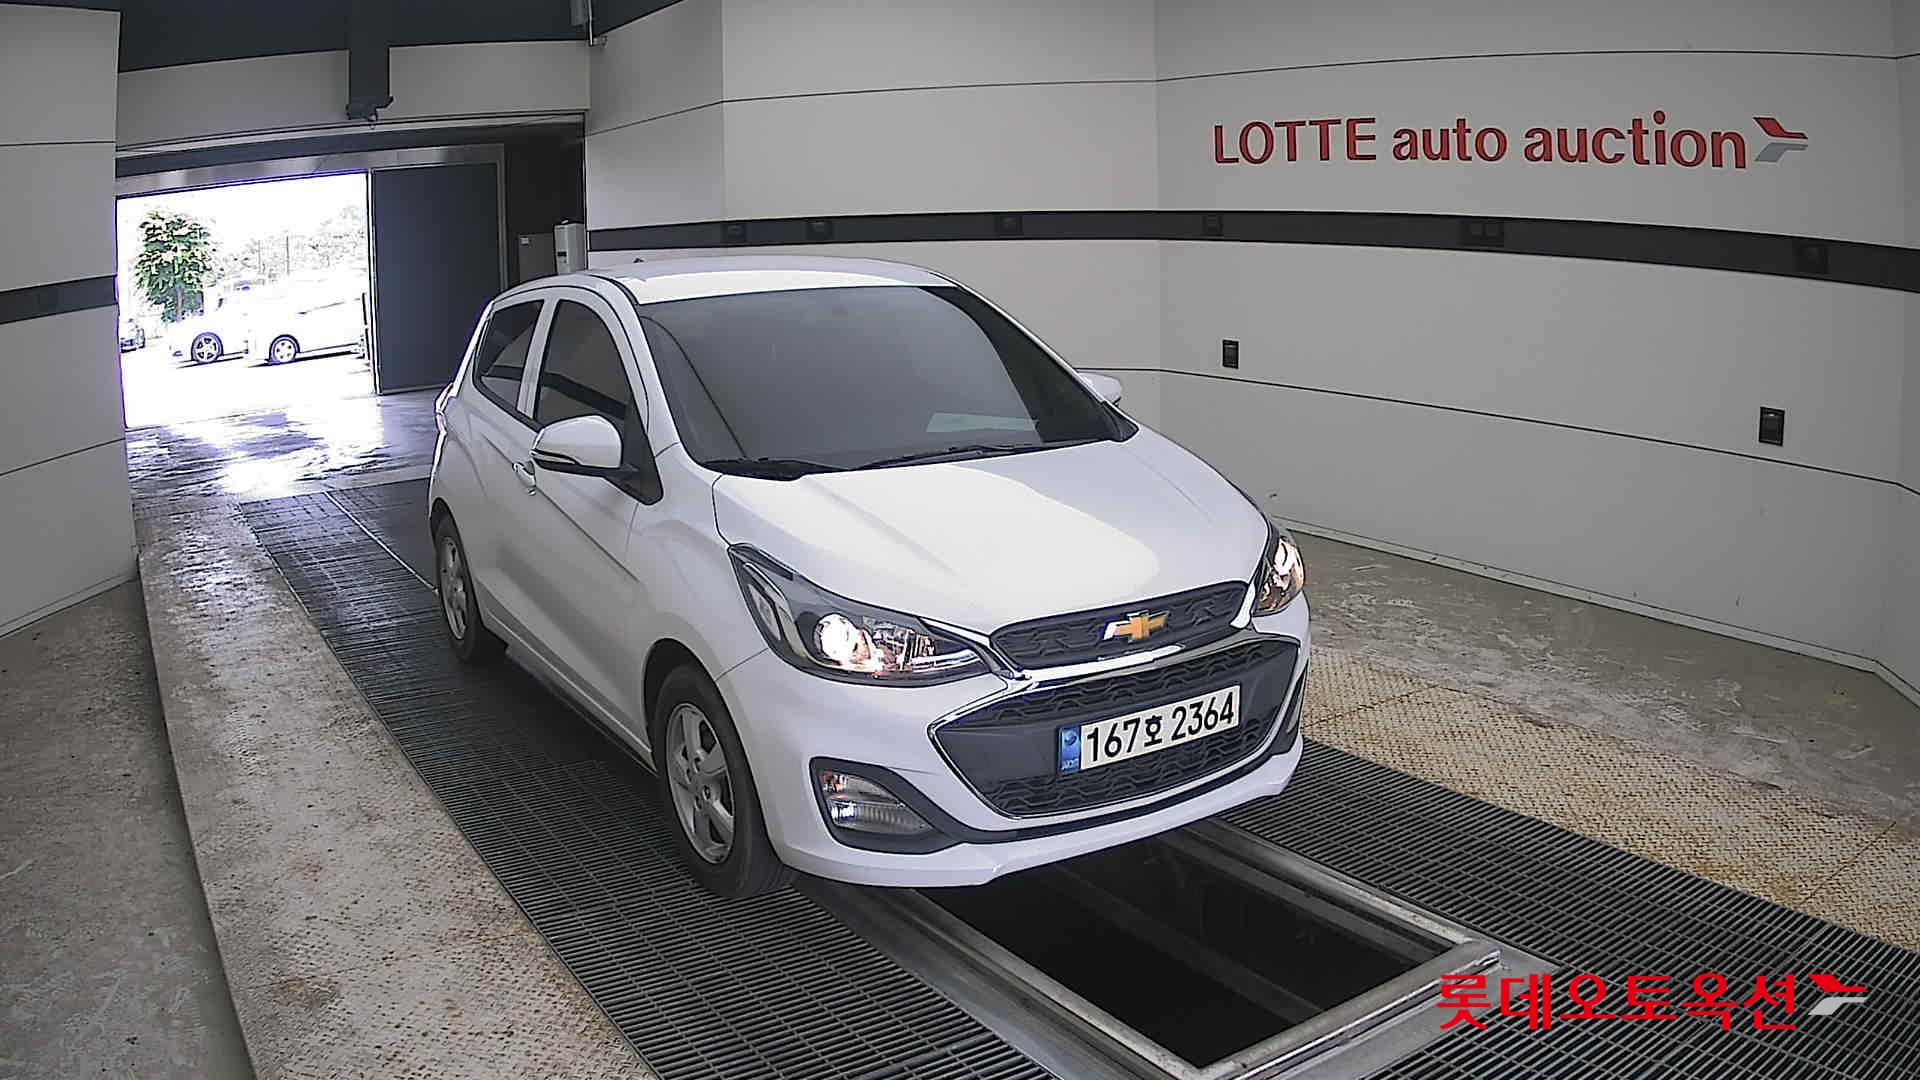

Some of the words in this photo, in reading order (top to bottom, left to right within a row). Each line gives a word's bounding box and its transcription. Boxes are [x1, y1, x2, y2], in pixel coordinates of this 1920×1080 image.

[1213, 116, 1378, 165] LOTTE
[1392, 117, 1508, 163] auto
[1523, 110, 1748, 169] auction
[1087, 715, 1163, 762] 167호
[1171, 691, 1235, 741] 2364
